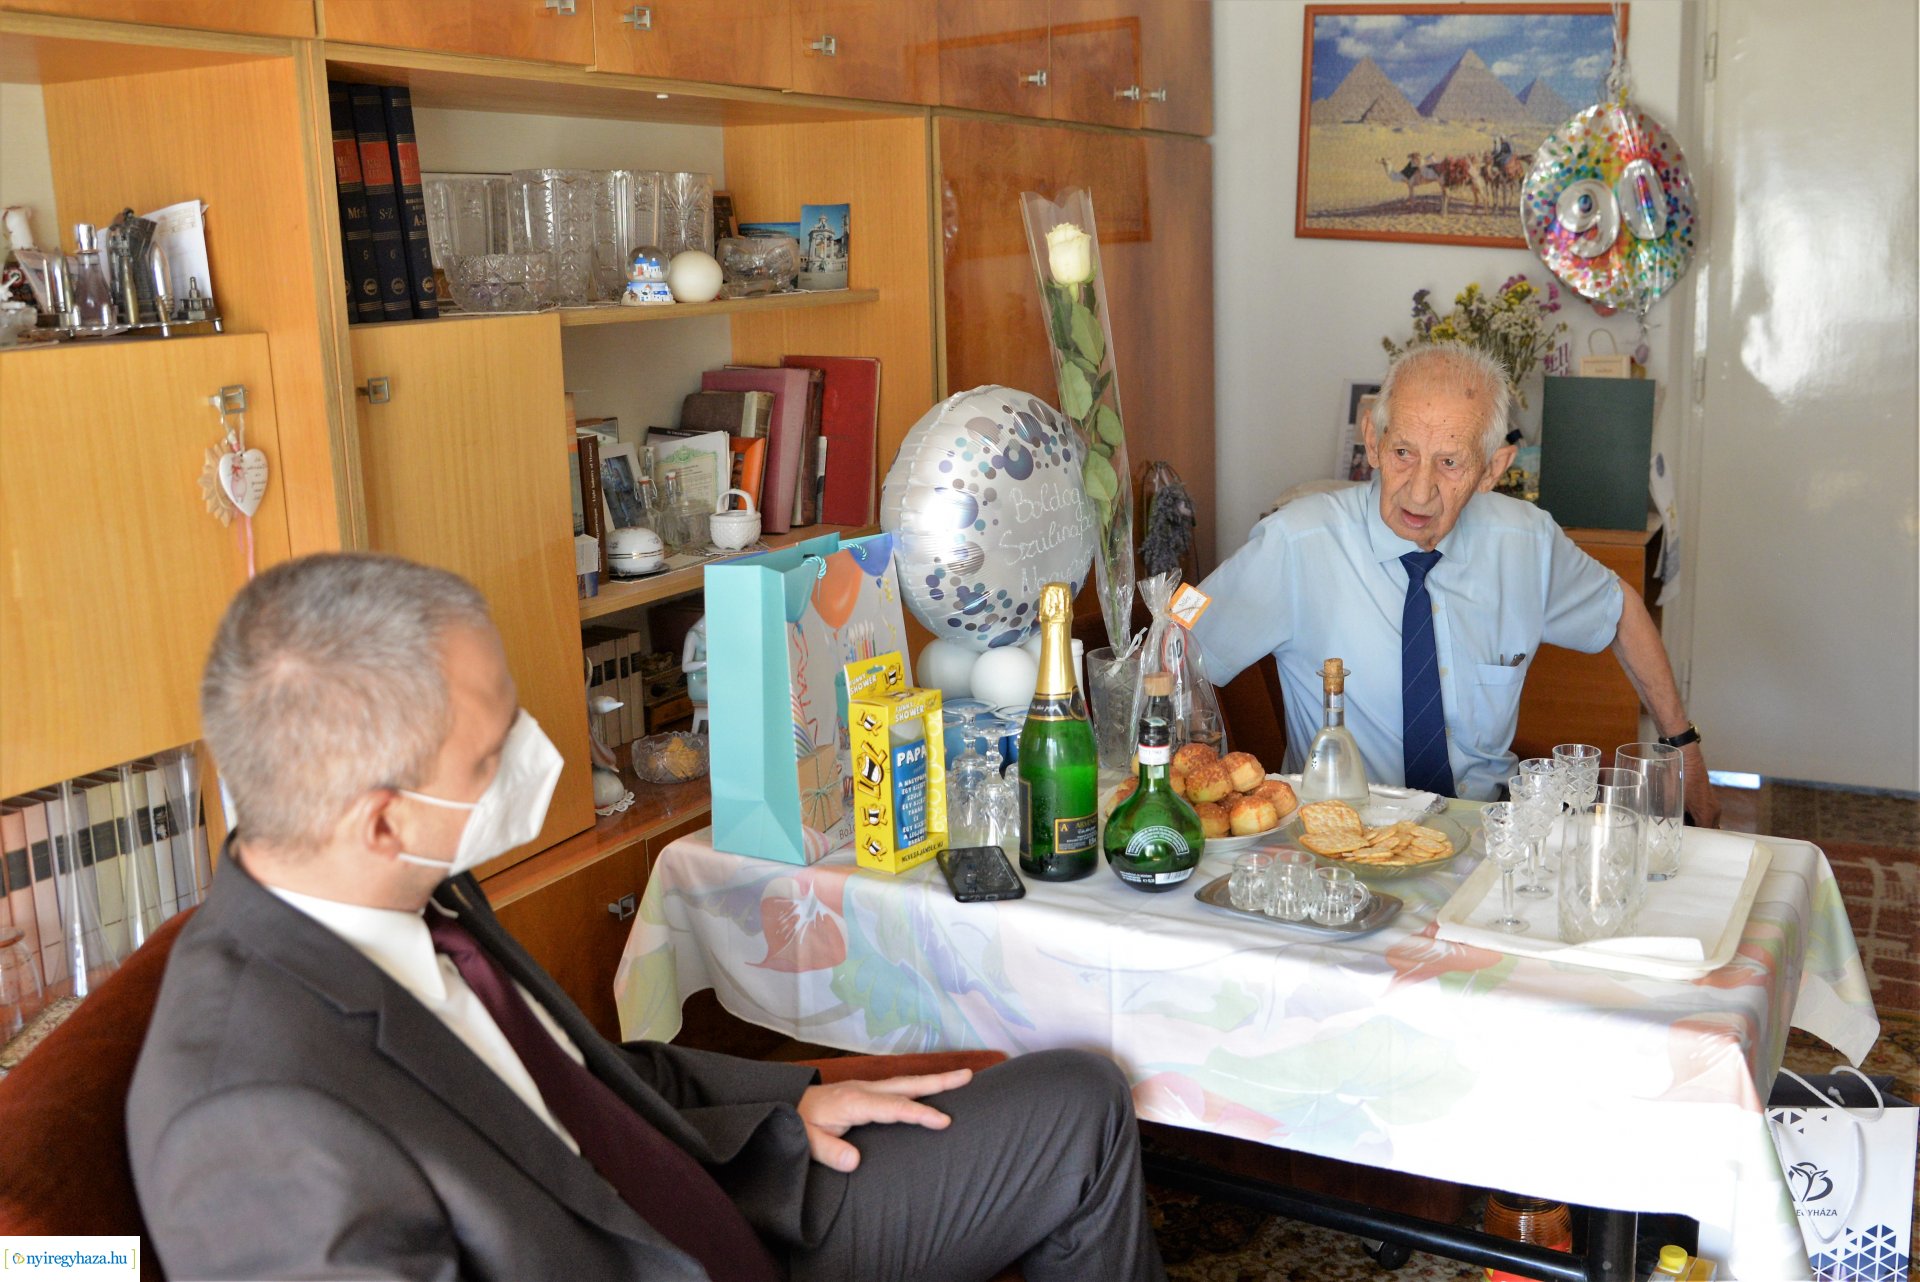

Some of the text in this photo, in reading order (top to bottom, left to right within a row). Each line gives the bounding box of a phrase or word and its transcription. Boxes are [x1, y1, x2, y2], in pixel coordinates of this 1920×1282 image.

[363, 249, 369, 260] 5
[389, 248, 396, 260] 6
[1009, 482, 1084, 524] Boldog
[850, 674, 877, 695] SHOWER
[895, 705, 924, 722] SHOWER
[896, 745, 927, 767] PAPA
[1060, 823, 1069, 832] A
